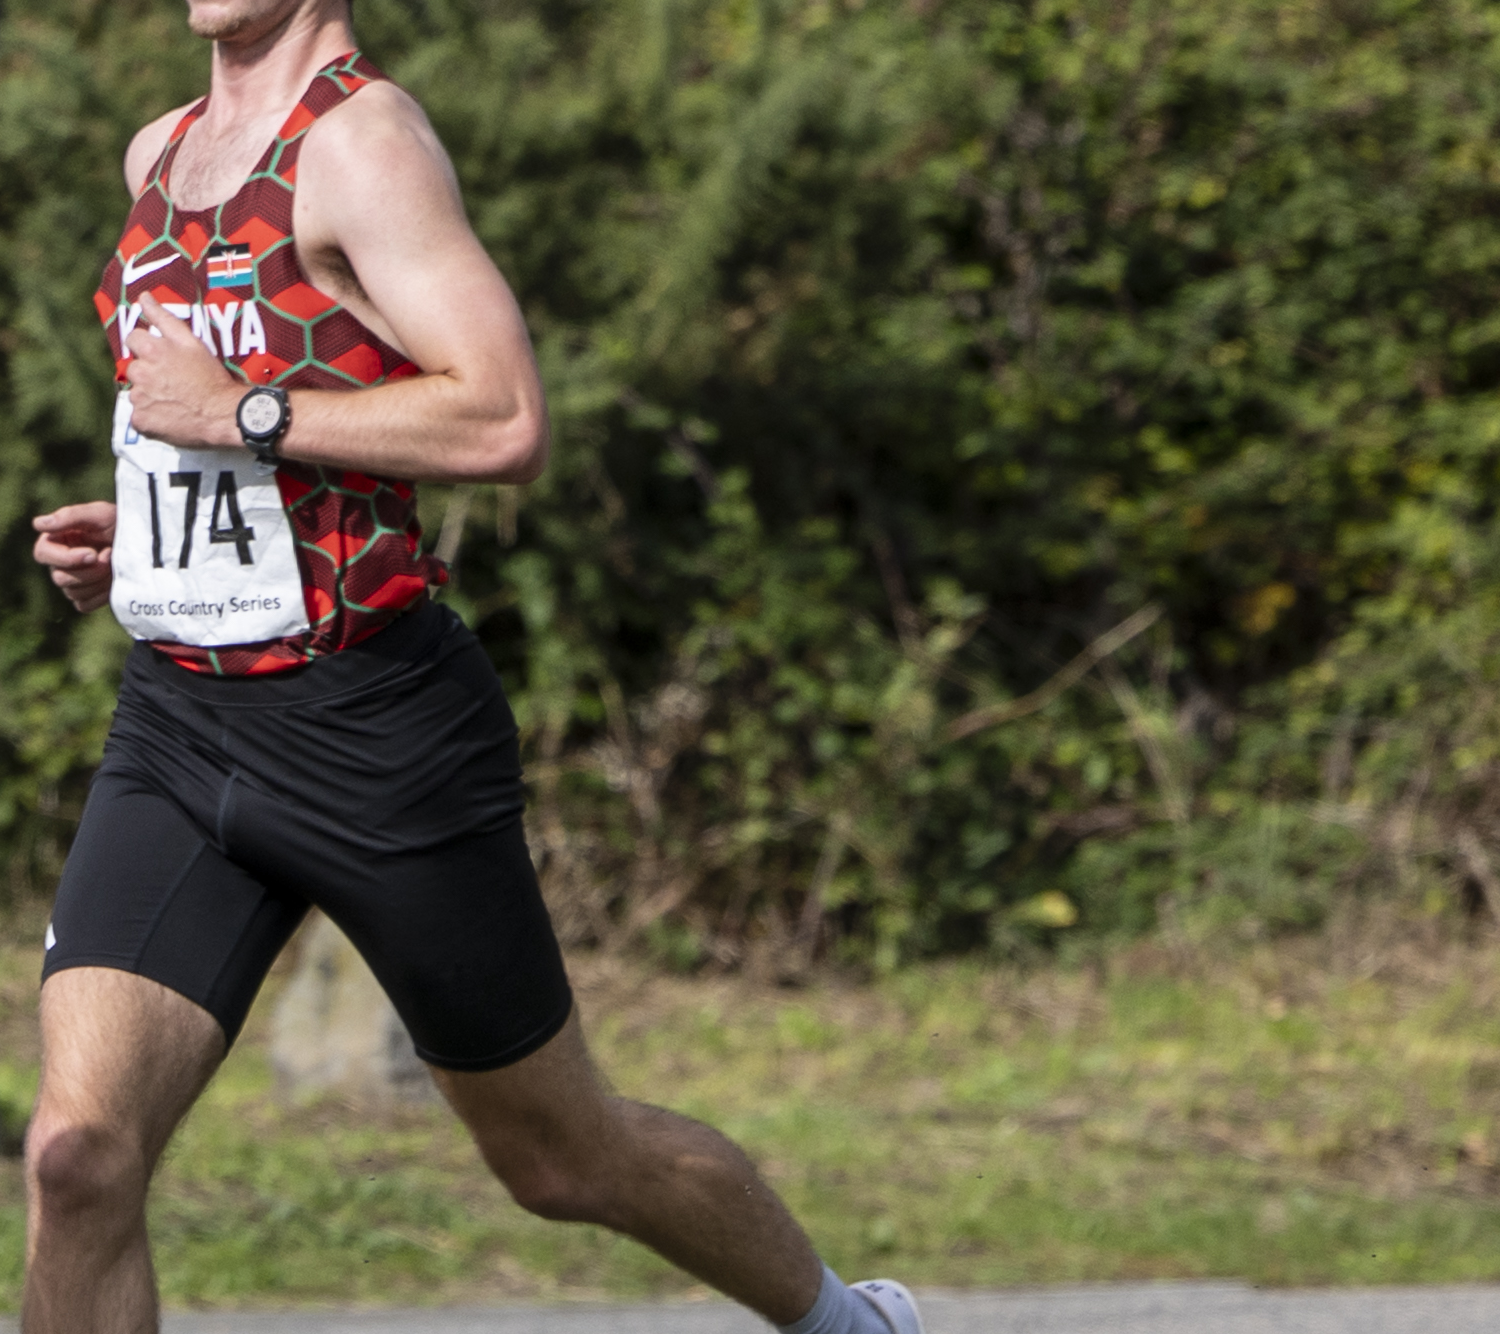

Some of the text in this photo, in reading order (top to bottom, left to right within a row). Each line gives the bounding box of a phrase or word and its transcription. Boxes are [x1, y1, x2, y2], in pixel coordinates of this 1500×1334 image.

[147, 471, 255, 569] 174
[129, 594, 281, 618] Cross Country Series
